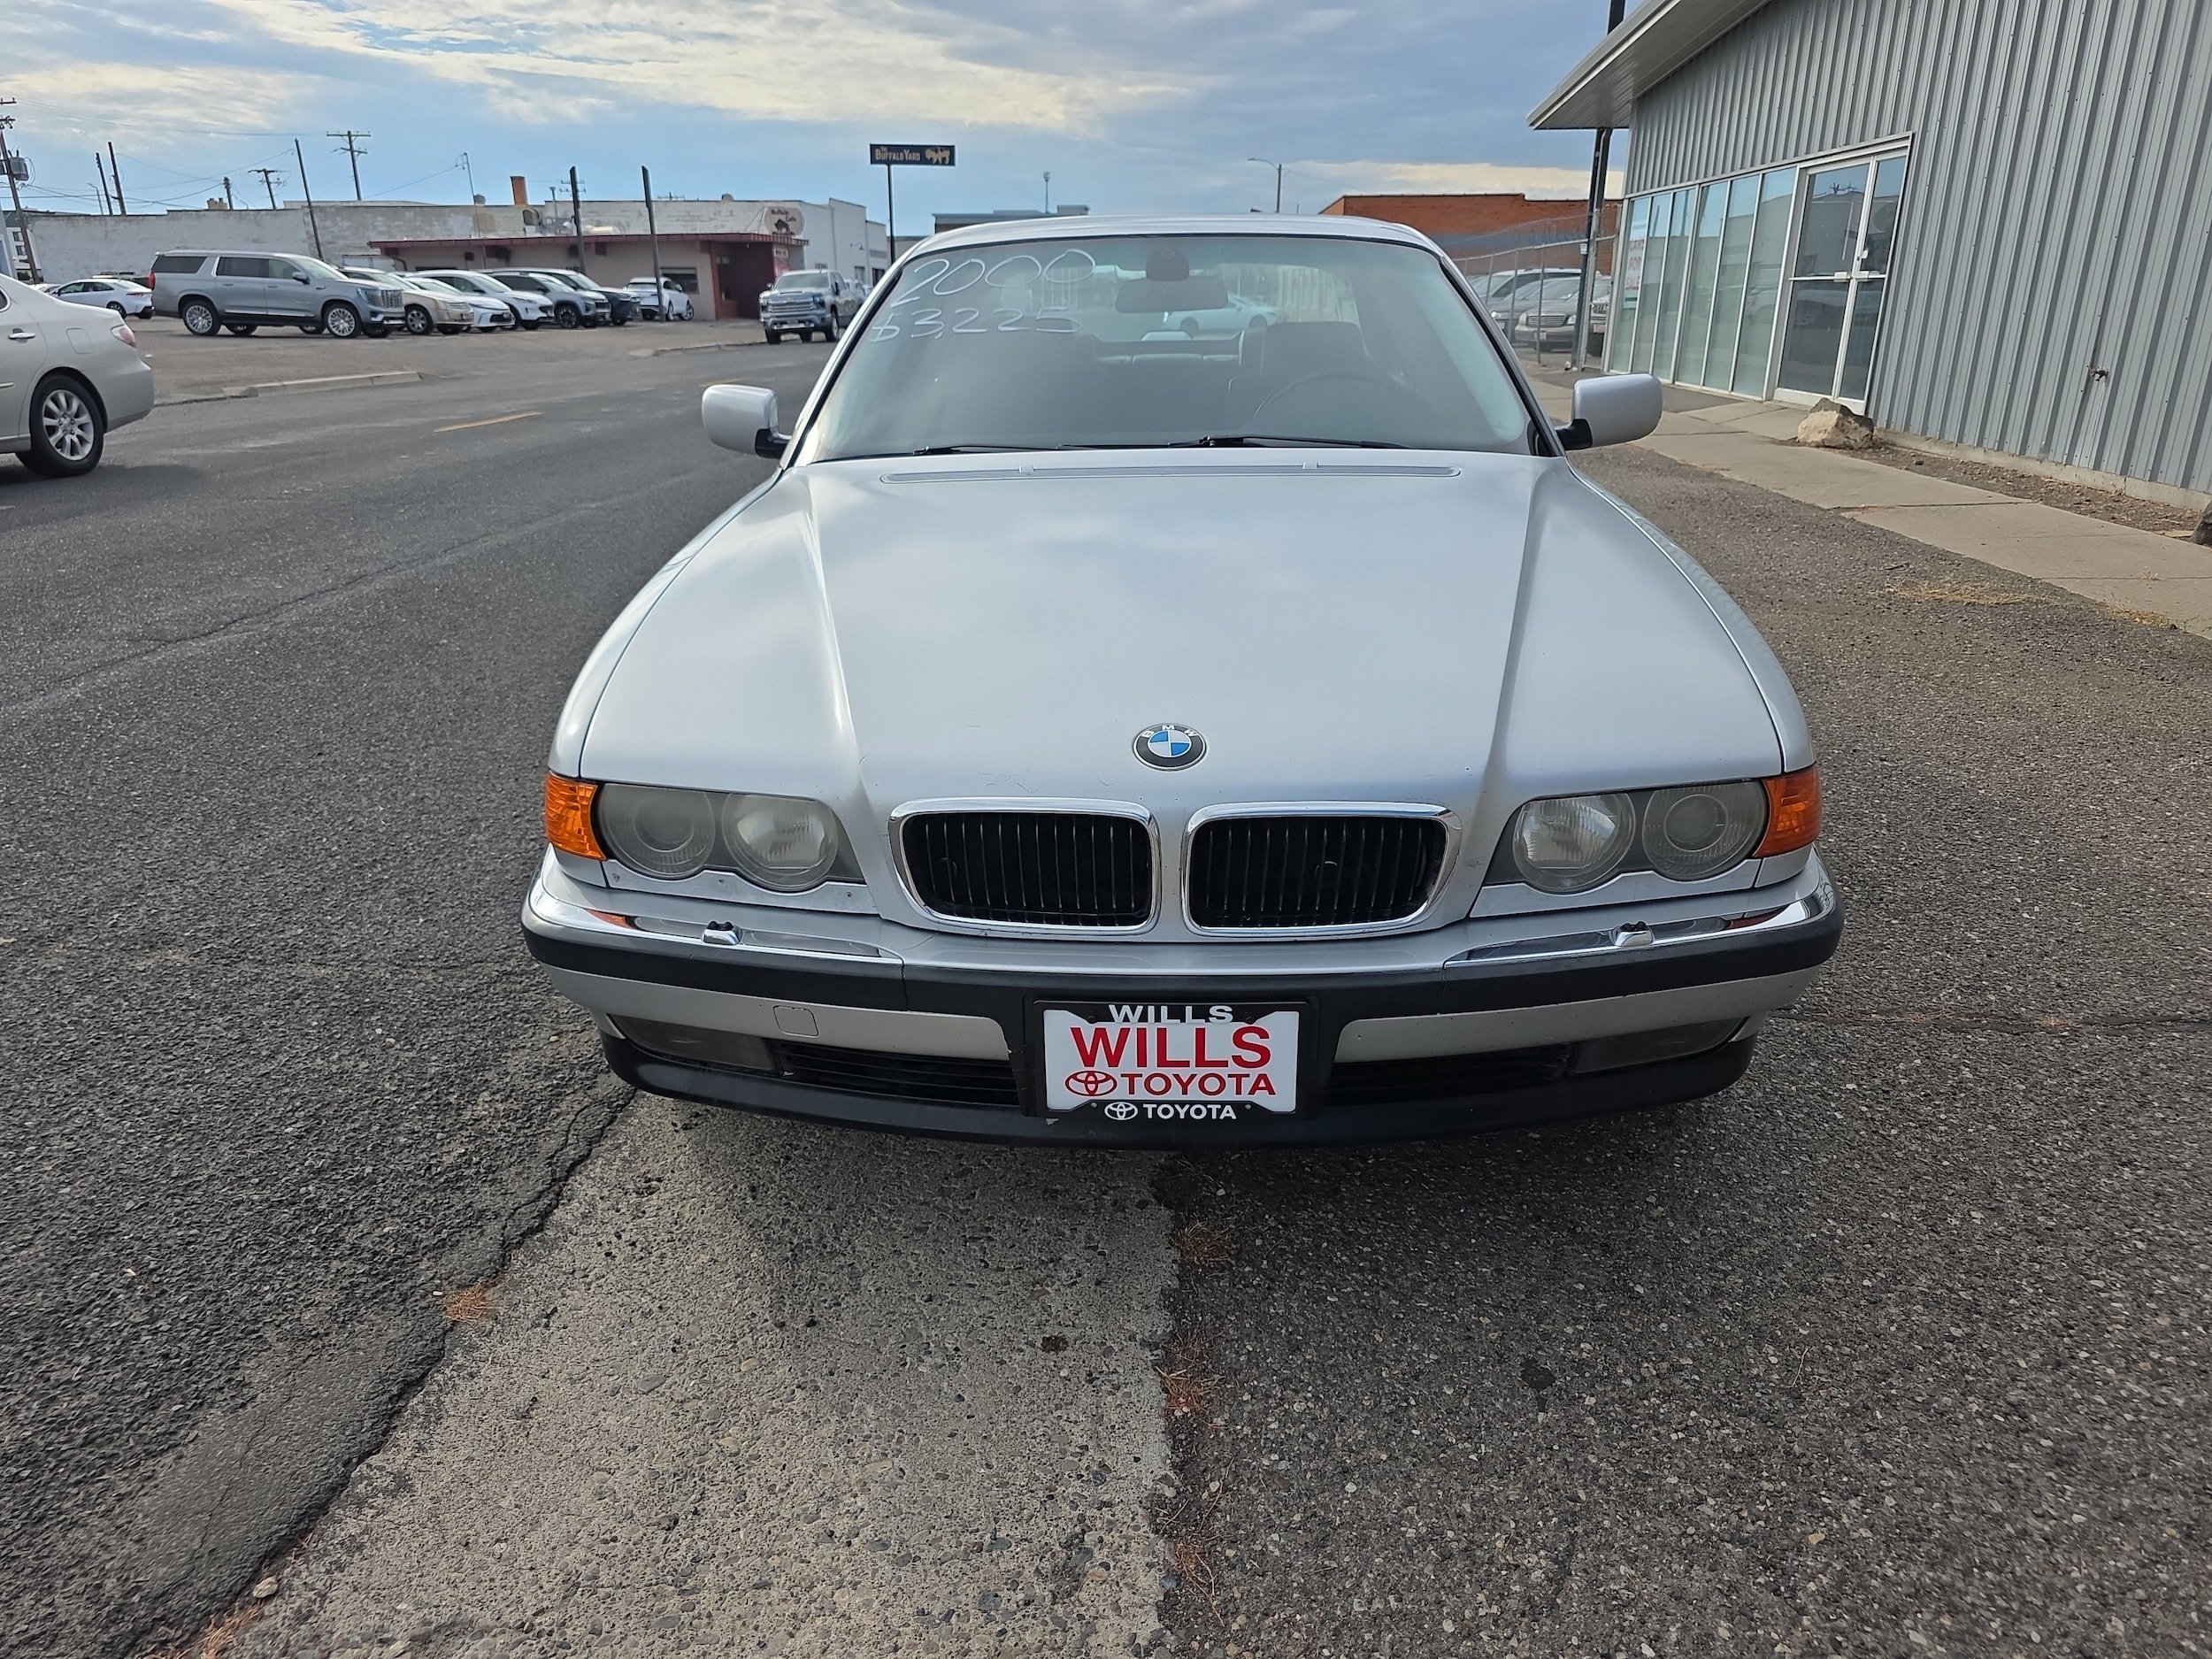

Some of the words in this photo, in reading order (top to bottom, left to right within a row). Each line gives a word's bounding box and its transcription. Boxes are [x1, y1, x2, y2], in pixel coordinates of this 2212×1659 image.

[890, 248, 1096, 309] 2000
[869, 306, 1084, 342] $3,225
[1141, 725, 1199, 738] BMW
[1108, 1004, 1233, 1024] WILLS
[1070, 1025, 1272, 1069] WILLS
[1119, 1072, 1277, 1096] TOYOTA
[1142, 1103, 1237, 1120] TOYOTA
